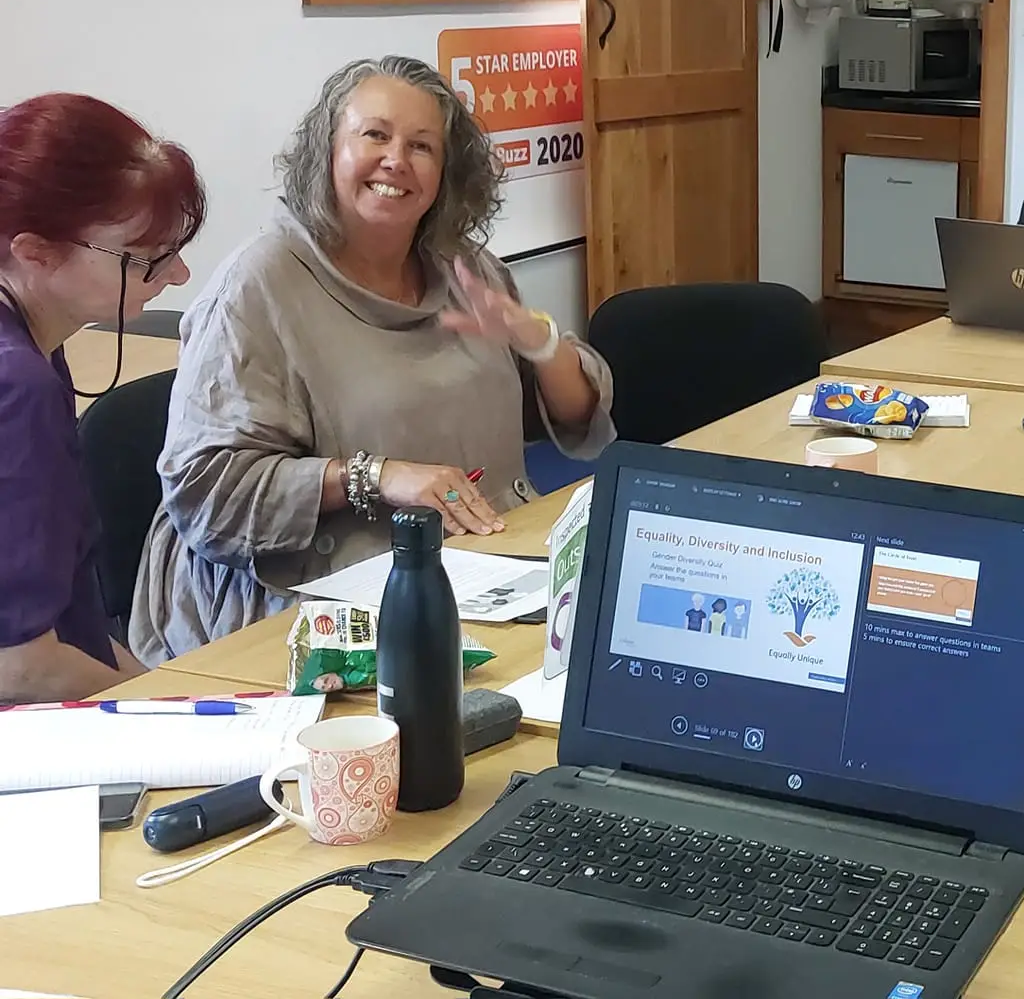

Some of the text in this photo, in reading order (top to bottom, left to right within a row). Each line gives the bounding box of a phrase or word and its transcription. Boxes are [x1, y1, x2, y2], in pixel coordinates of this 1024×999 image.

[451, 49, 577, 114] 5 STAR EMPLOYER
[537, 132, 584, 166] 2020
[636, 528, 822, 566] Equality, Diversity and Inclusion
[652, 551, 677, 561] Gender
[677, 555, 706, 567] Diversity
[557, 546, 581, 581] Outs
[650, 563, 676, 572] Answer
[688, 569, 720, 580] questions
[865, 623, 874, 632] 10
[874, 625, 890, 634] mins
[891, 628, 905, 637] max
[906, 630, 914, 638] to
[914, 633, 939, 642] answer
[939, 637, 972, 648] questions
[981, 643, 1001, 653] teams
[868, 634, 885, 643] mins
[886, 637, 893, 645] to
[894, 640, 917, 649] ensure
[917, 643, 941, 653] correct
[942, 647, 969, 657] answers
[769, 649, 824, 665] Equally Unique
